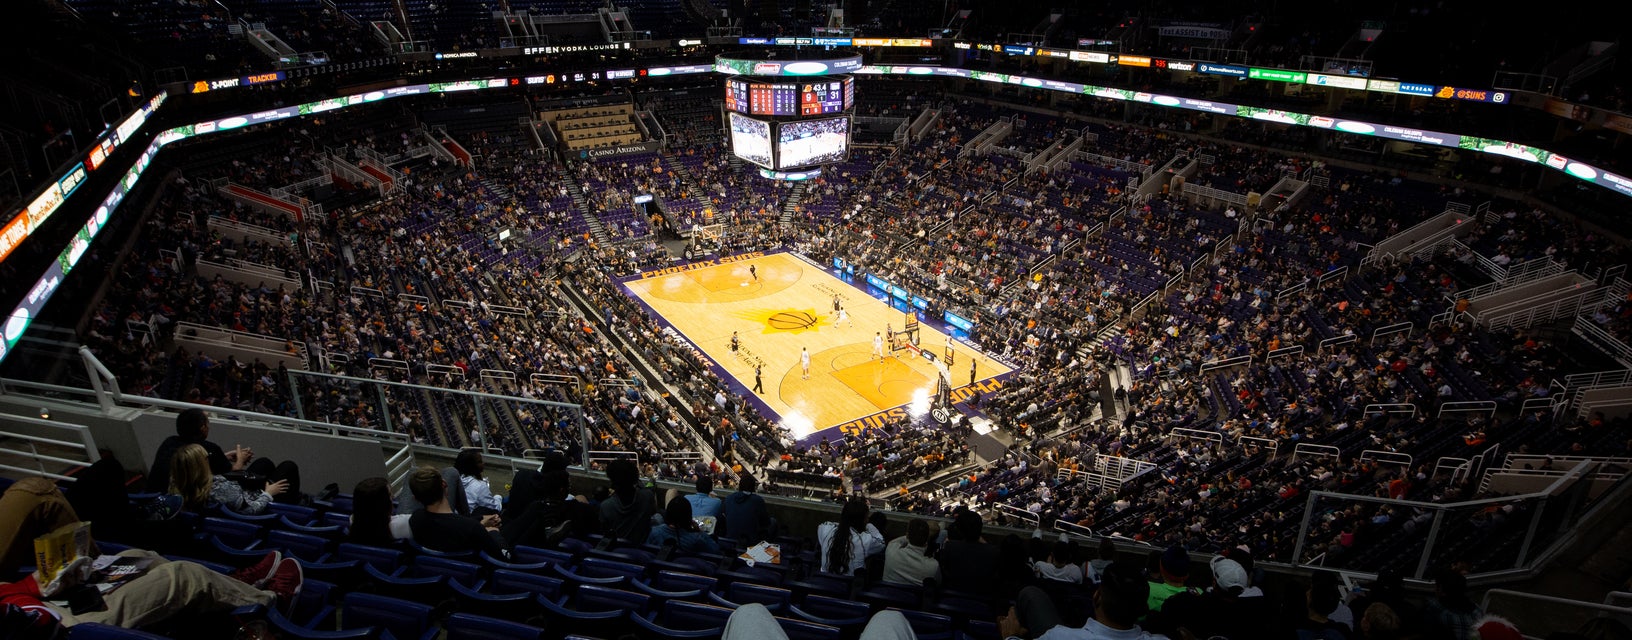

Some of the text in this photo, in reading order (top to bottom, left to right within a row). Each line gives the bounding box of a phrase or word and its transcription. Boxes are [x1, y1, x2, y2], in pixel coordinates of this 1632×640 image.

[1175, 29, 1200, 37] ASSIST
[524, 46, 560, 55] EFFEN
[1168, 61, 1192, 71] verizon
[211, 73, 277, 90] 3-POINT TRACKER
[806, 93, 812, 102] 9
[830, 91, 839, 100] 31
[1457, 89, 1486, 100] @SUNS
[641, 252, 765, 279] PHOENIX SUNS
[934, 411, 946, 422] KIA
[838, 407, 907, 438] SUNS
